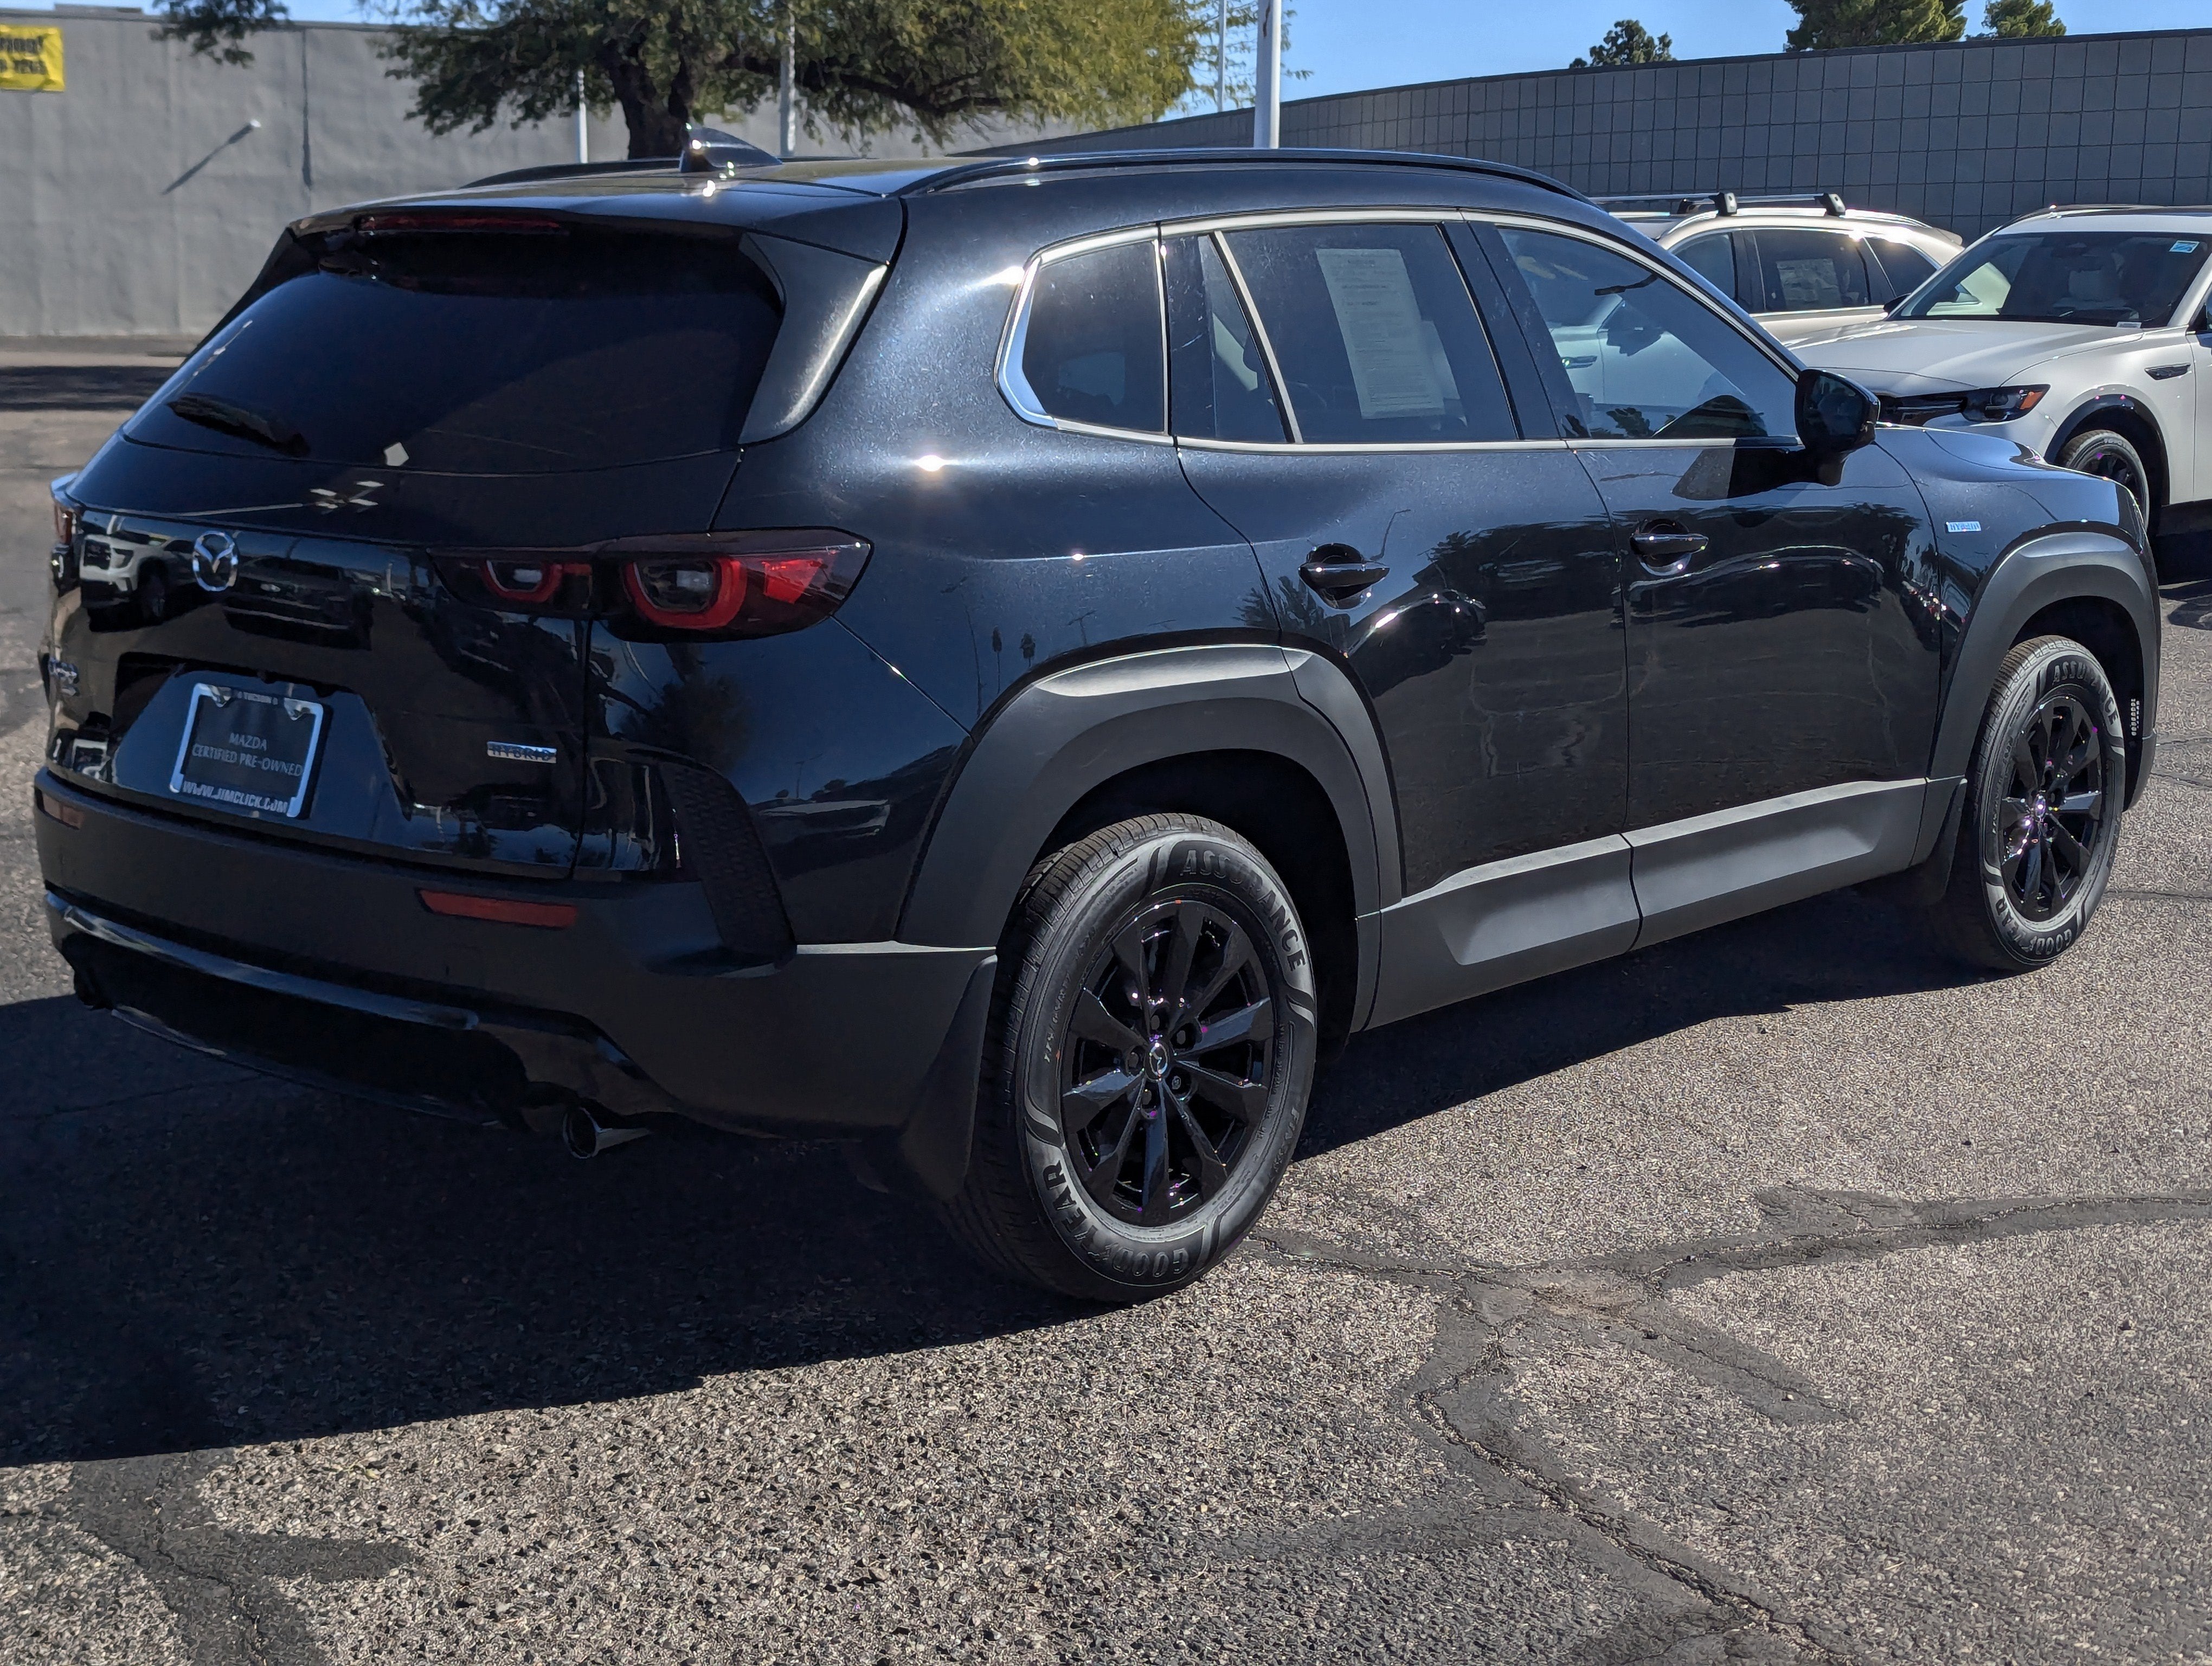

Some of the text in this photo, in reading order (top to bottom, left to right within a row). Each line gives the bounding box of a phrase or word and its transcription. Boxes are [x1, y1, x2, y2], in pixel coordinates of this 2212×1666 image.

[229, 732, 267, 751] MAZDA
[191, 744, 304, 777] CERTIFIED PRE-OWNED
[182, 780, 289, 813] WWW.JIMCLICK.COM
[1179, 849, 1306, 972] ASSURANCE
